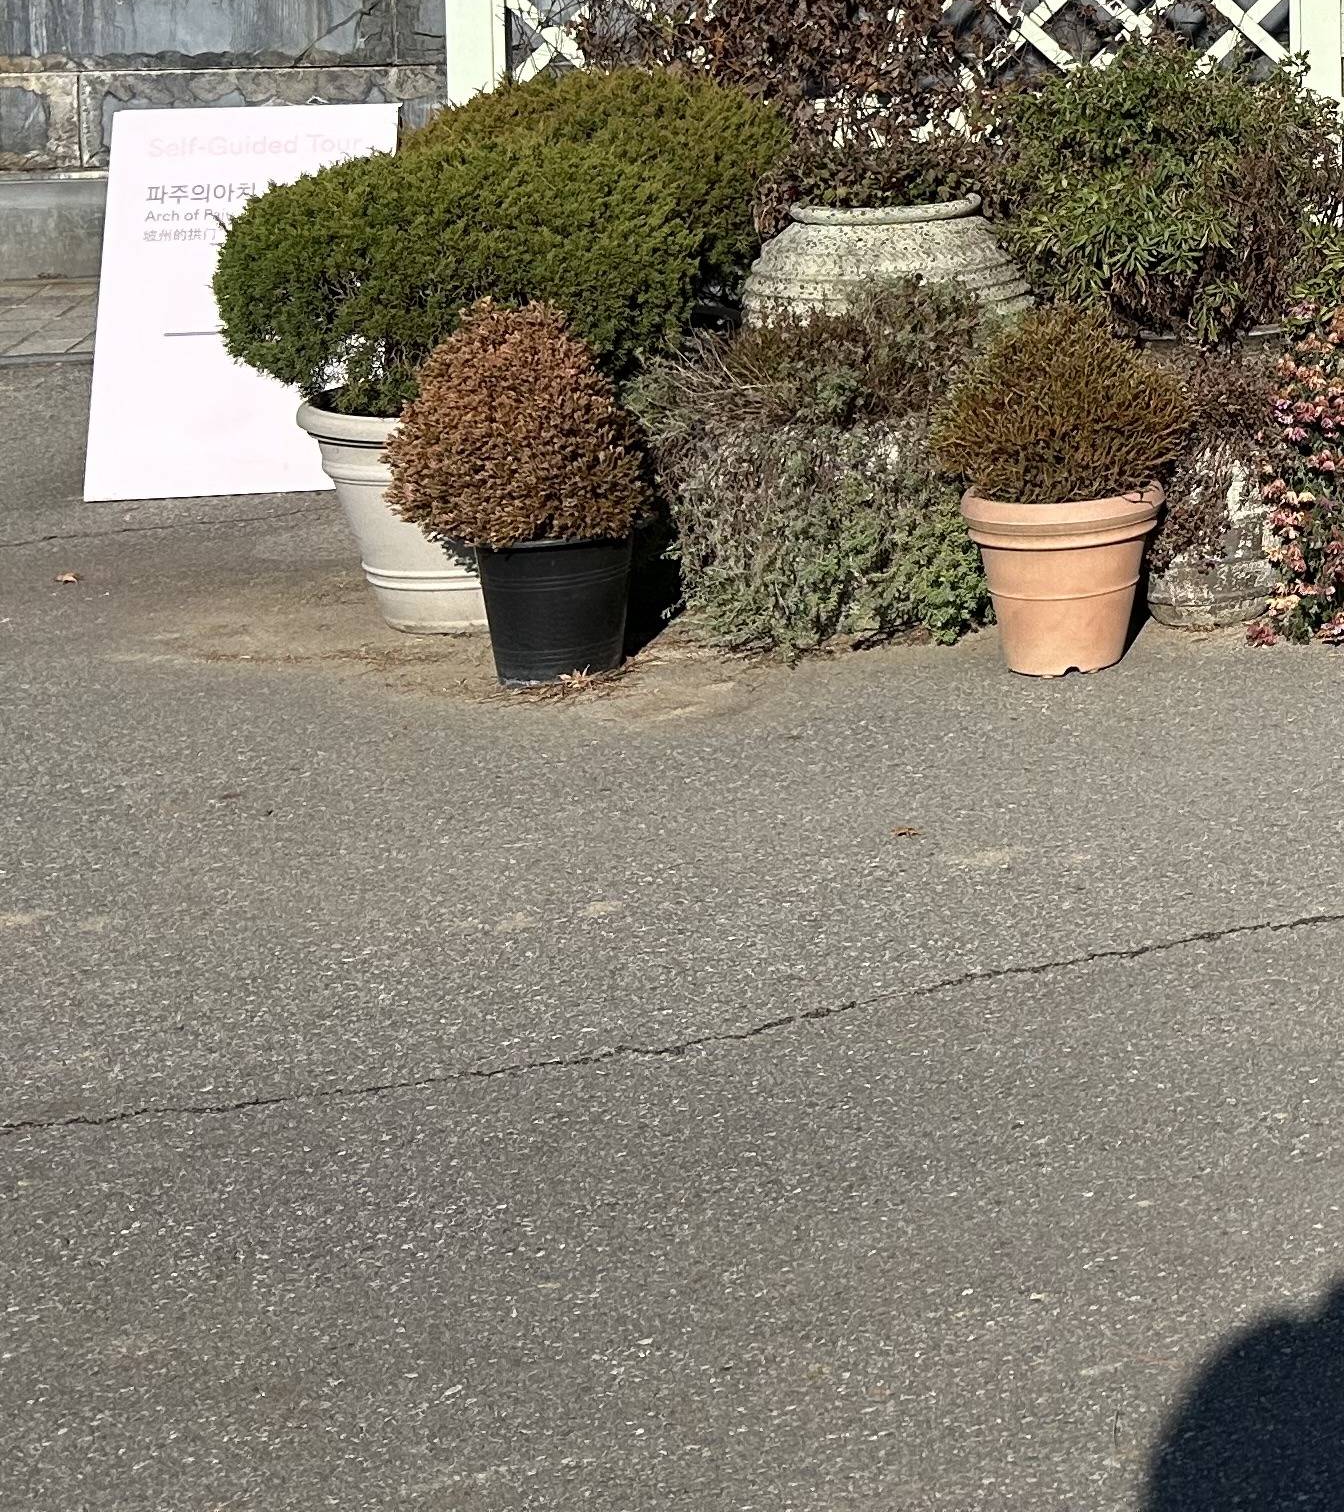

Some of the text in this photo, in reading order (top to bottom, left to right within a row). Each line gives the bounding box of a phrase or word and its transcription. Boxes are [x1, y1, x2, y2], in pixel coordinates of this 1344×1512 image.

[148, 133, 363, 158] Self-Guided Tour
[144, 210, 180, 222] Arch
[184, 209, 200, 221] of
